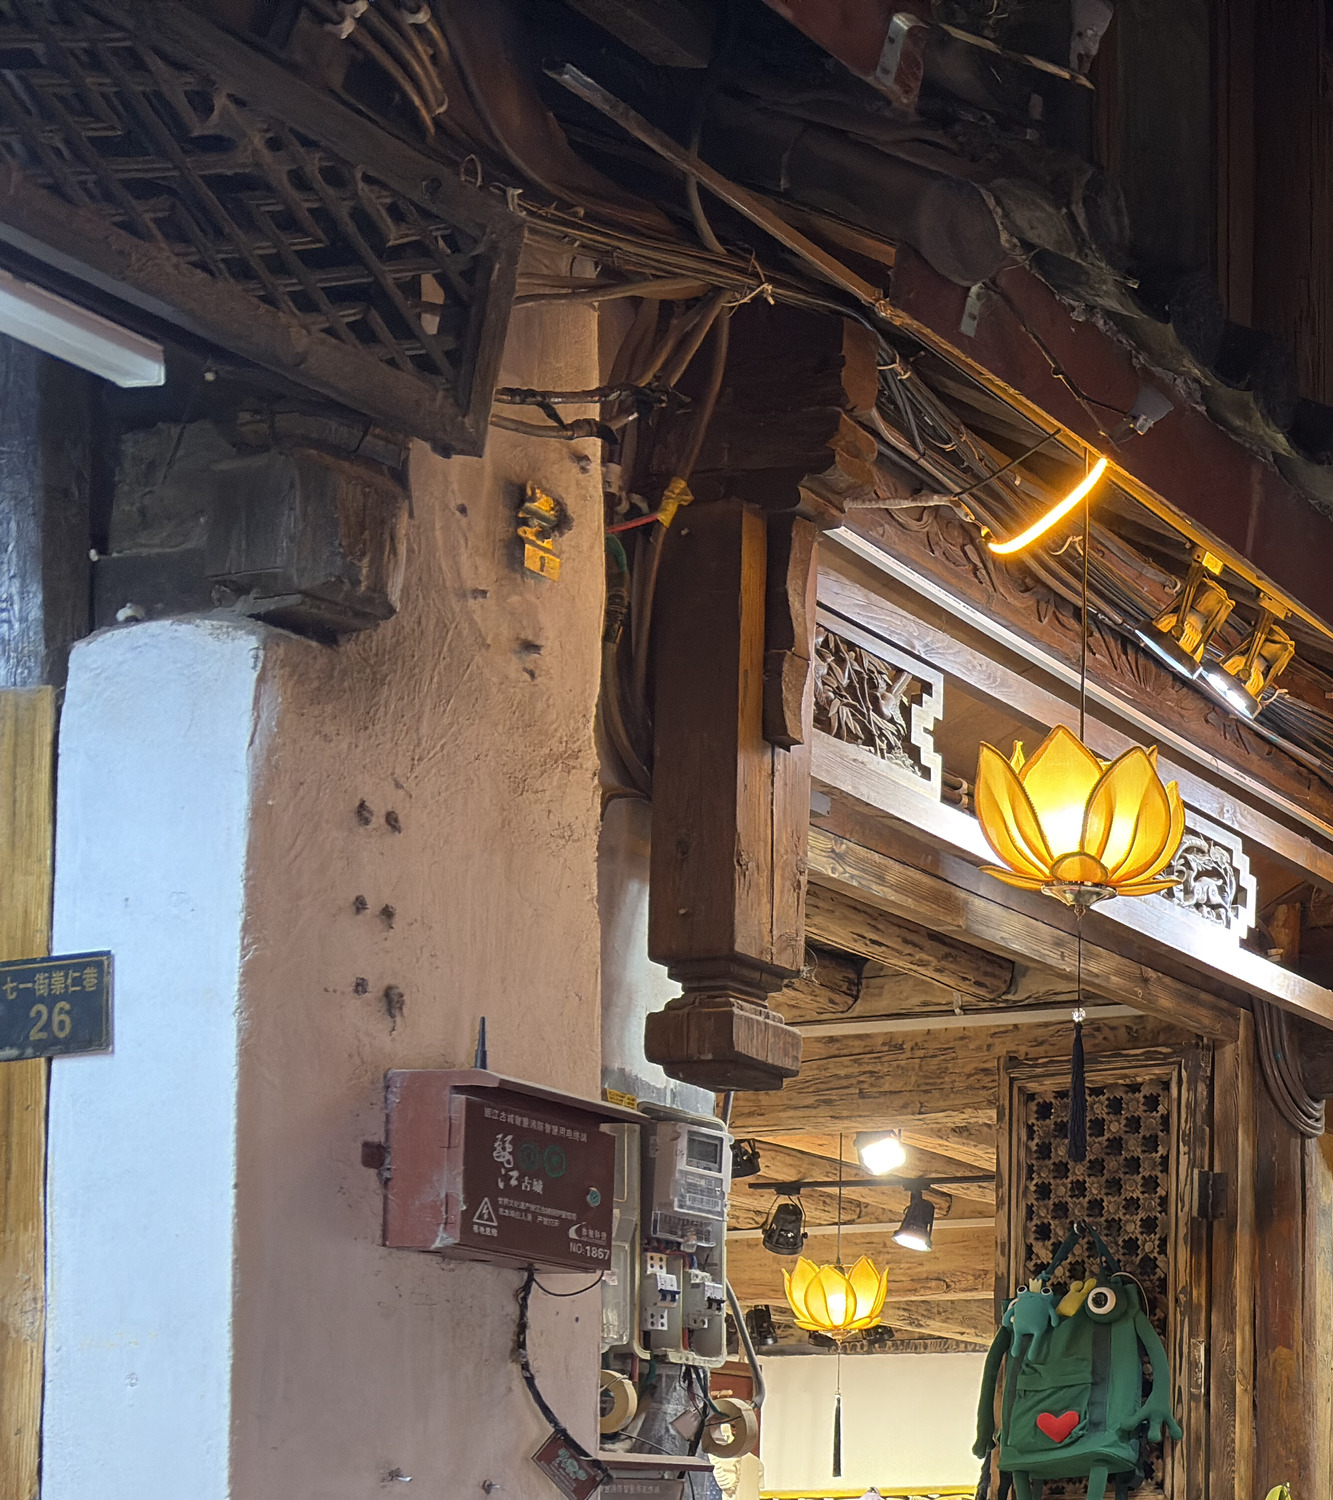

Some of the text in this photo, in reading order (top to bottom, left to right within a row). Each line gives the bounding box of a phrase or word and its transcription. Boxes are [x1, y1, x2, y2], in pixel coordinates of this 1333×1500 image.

[2, 966, 98, 1000] 七一街崇仁巷
[29, 1001, 72, 1041] 26
